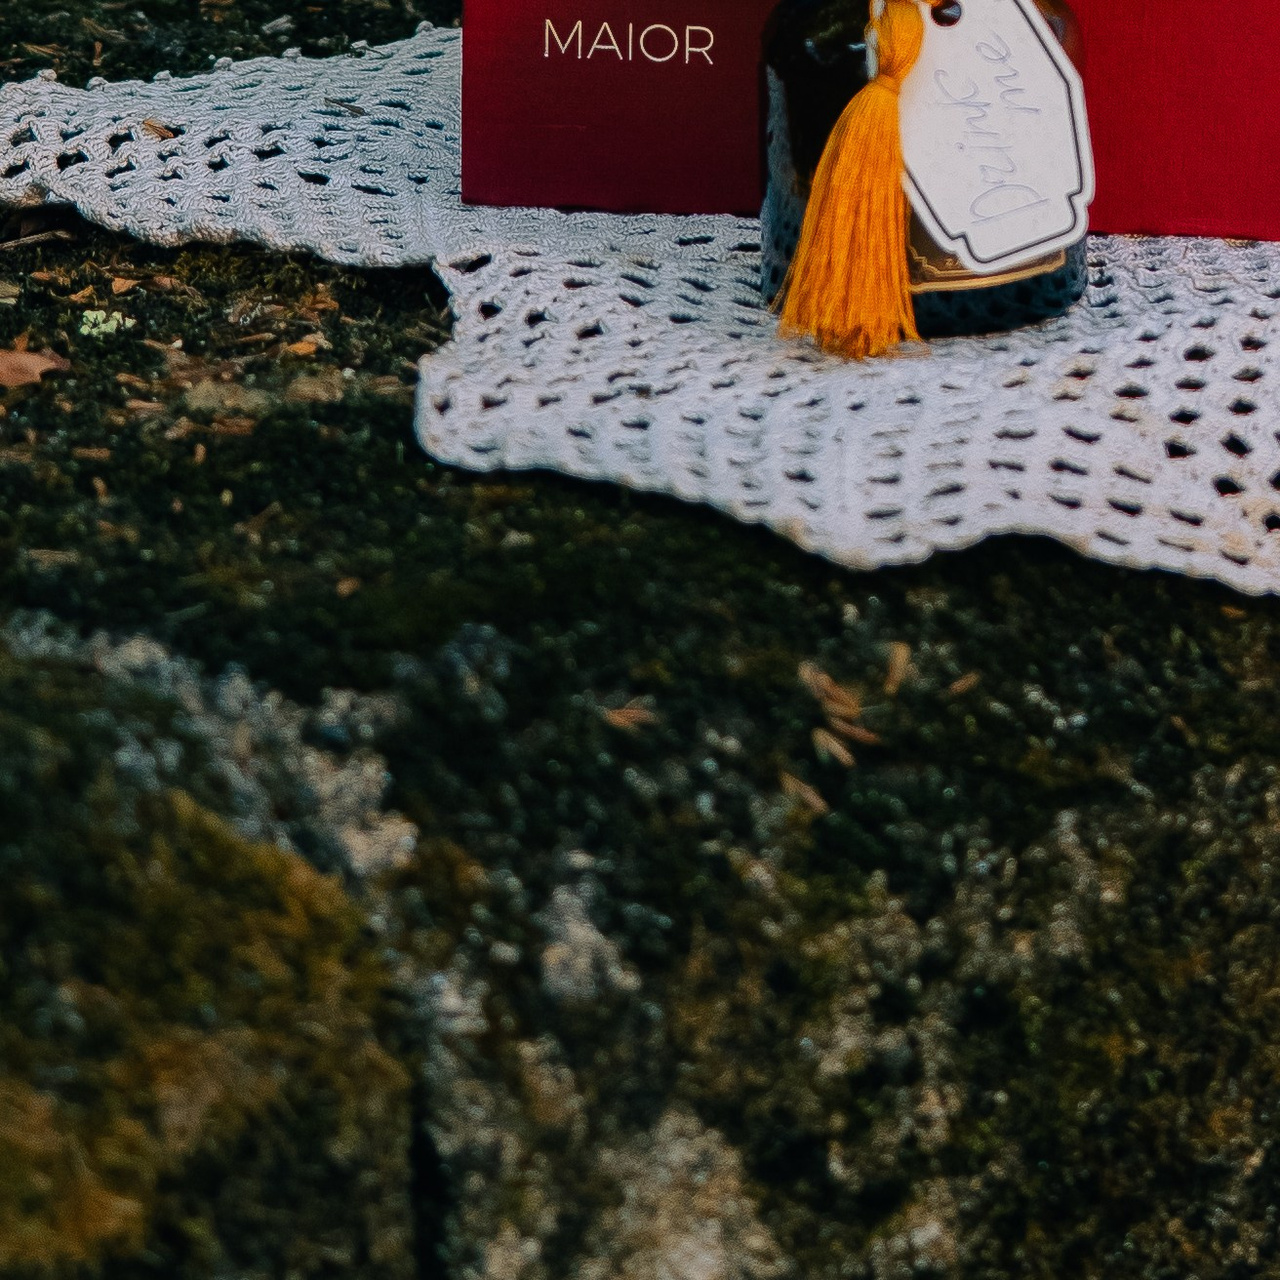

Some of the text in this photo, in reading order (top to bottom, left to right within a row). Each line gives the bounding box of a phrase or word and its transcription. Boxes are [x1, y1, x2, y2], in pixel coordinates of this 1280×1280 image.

[542, 18, 716, 66] MAIOR
[975, 32, 1043, 116] me
[932, 68, 1051, 225] Drink
